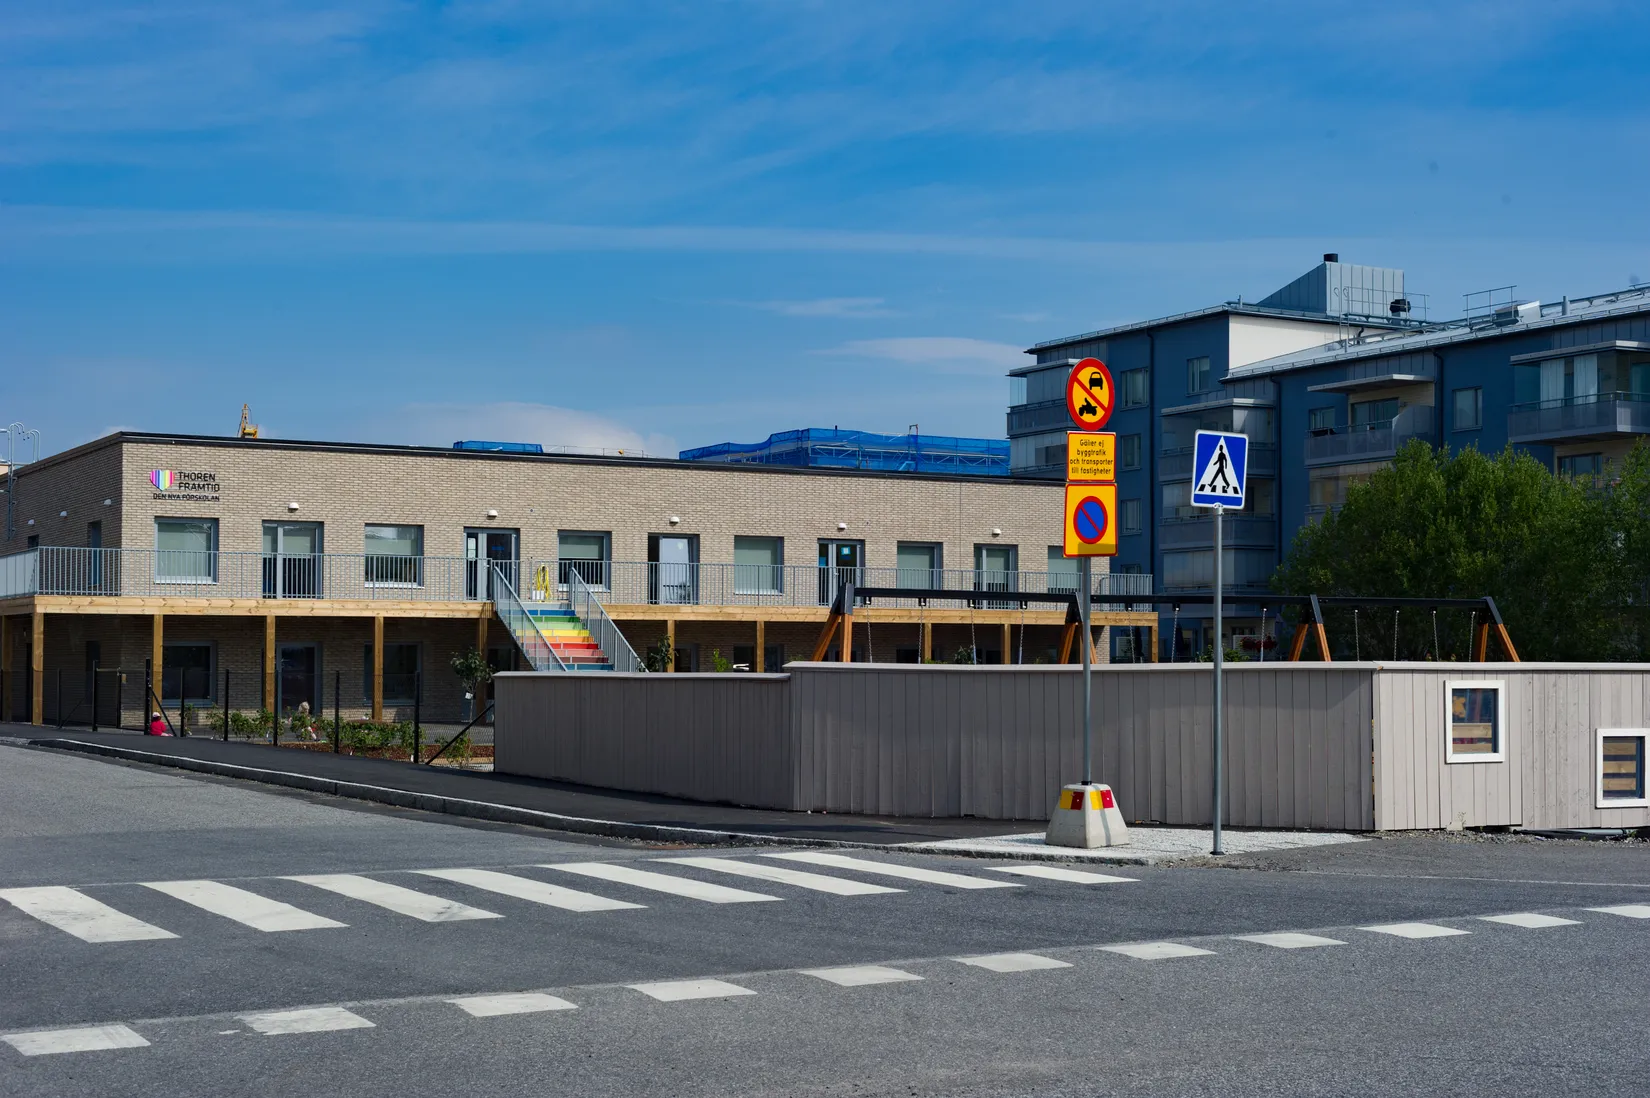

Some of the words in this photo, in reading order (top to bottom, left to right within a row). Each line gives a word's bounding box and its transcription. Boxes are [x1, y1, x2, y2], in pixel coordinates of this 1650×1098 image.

[1098, 440, 1104, 448] ej
[1077, 449, 1106, 457] byggtrafik
[1082, 458, 1113, 466] transporter
[1080, 467, 1111, 476] fastigheter
[178, 471, 216, 482] THOREN
[178, 482, 220, 492] FRAMTID
[182, 493, 220, 502] FÖRSKOLAN
